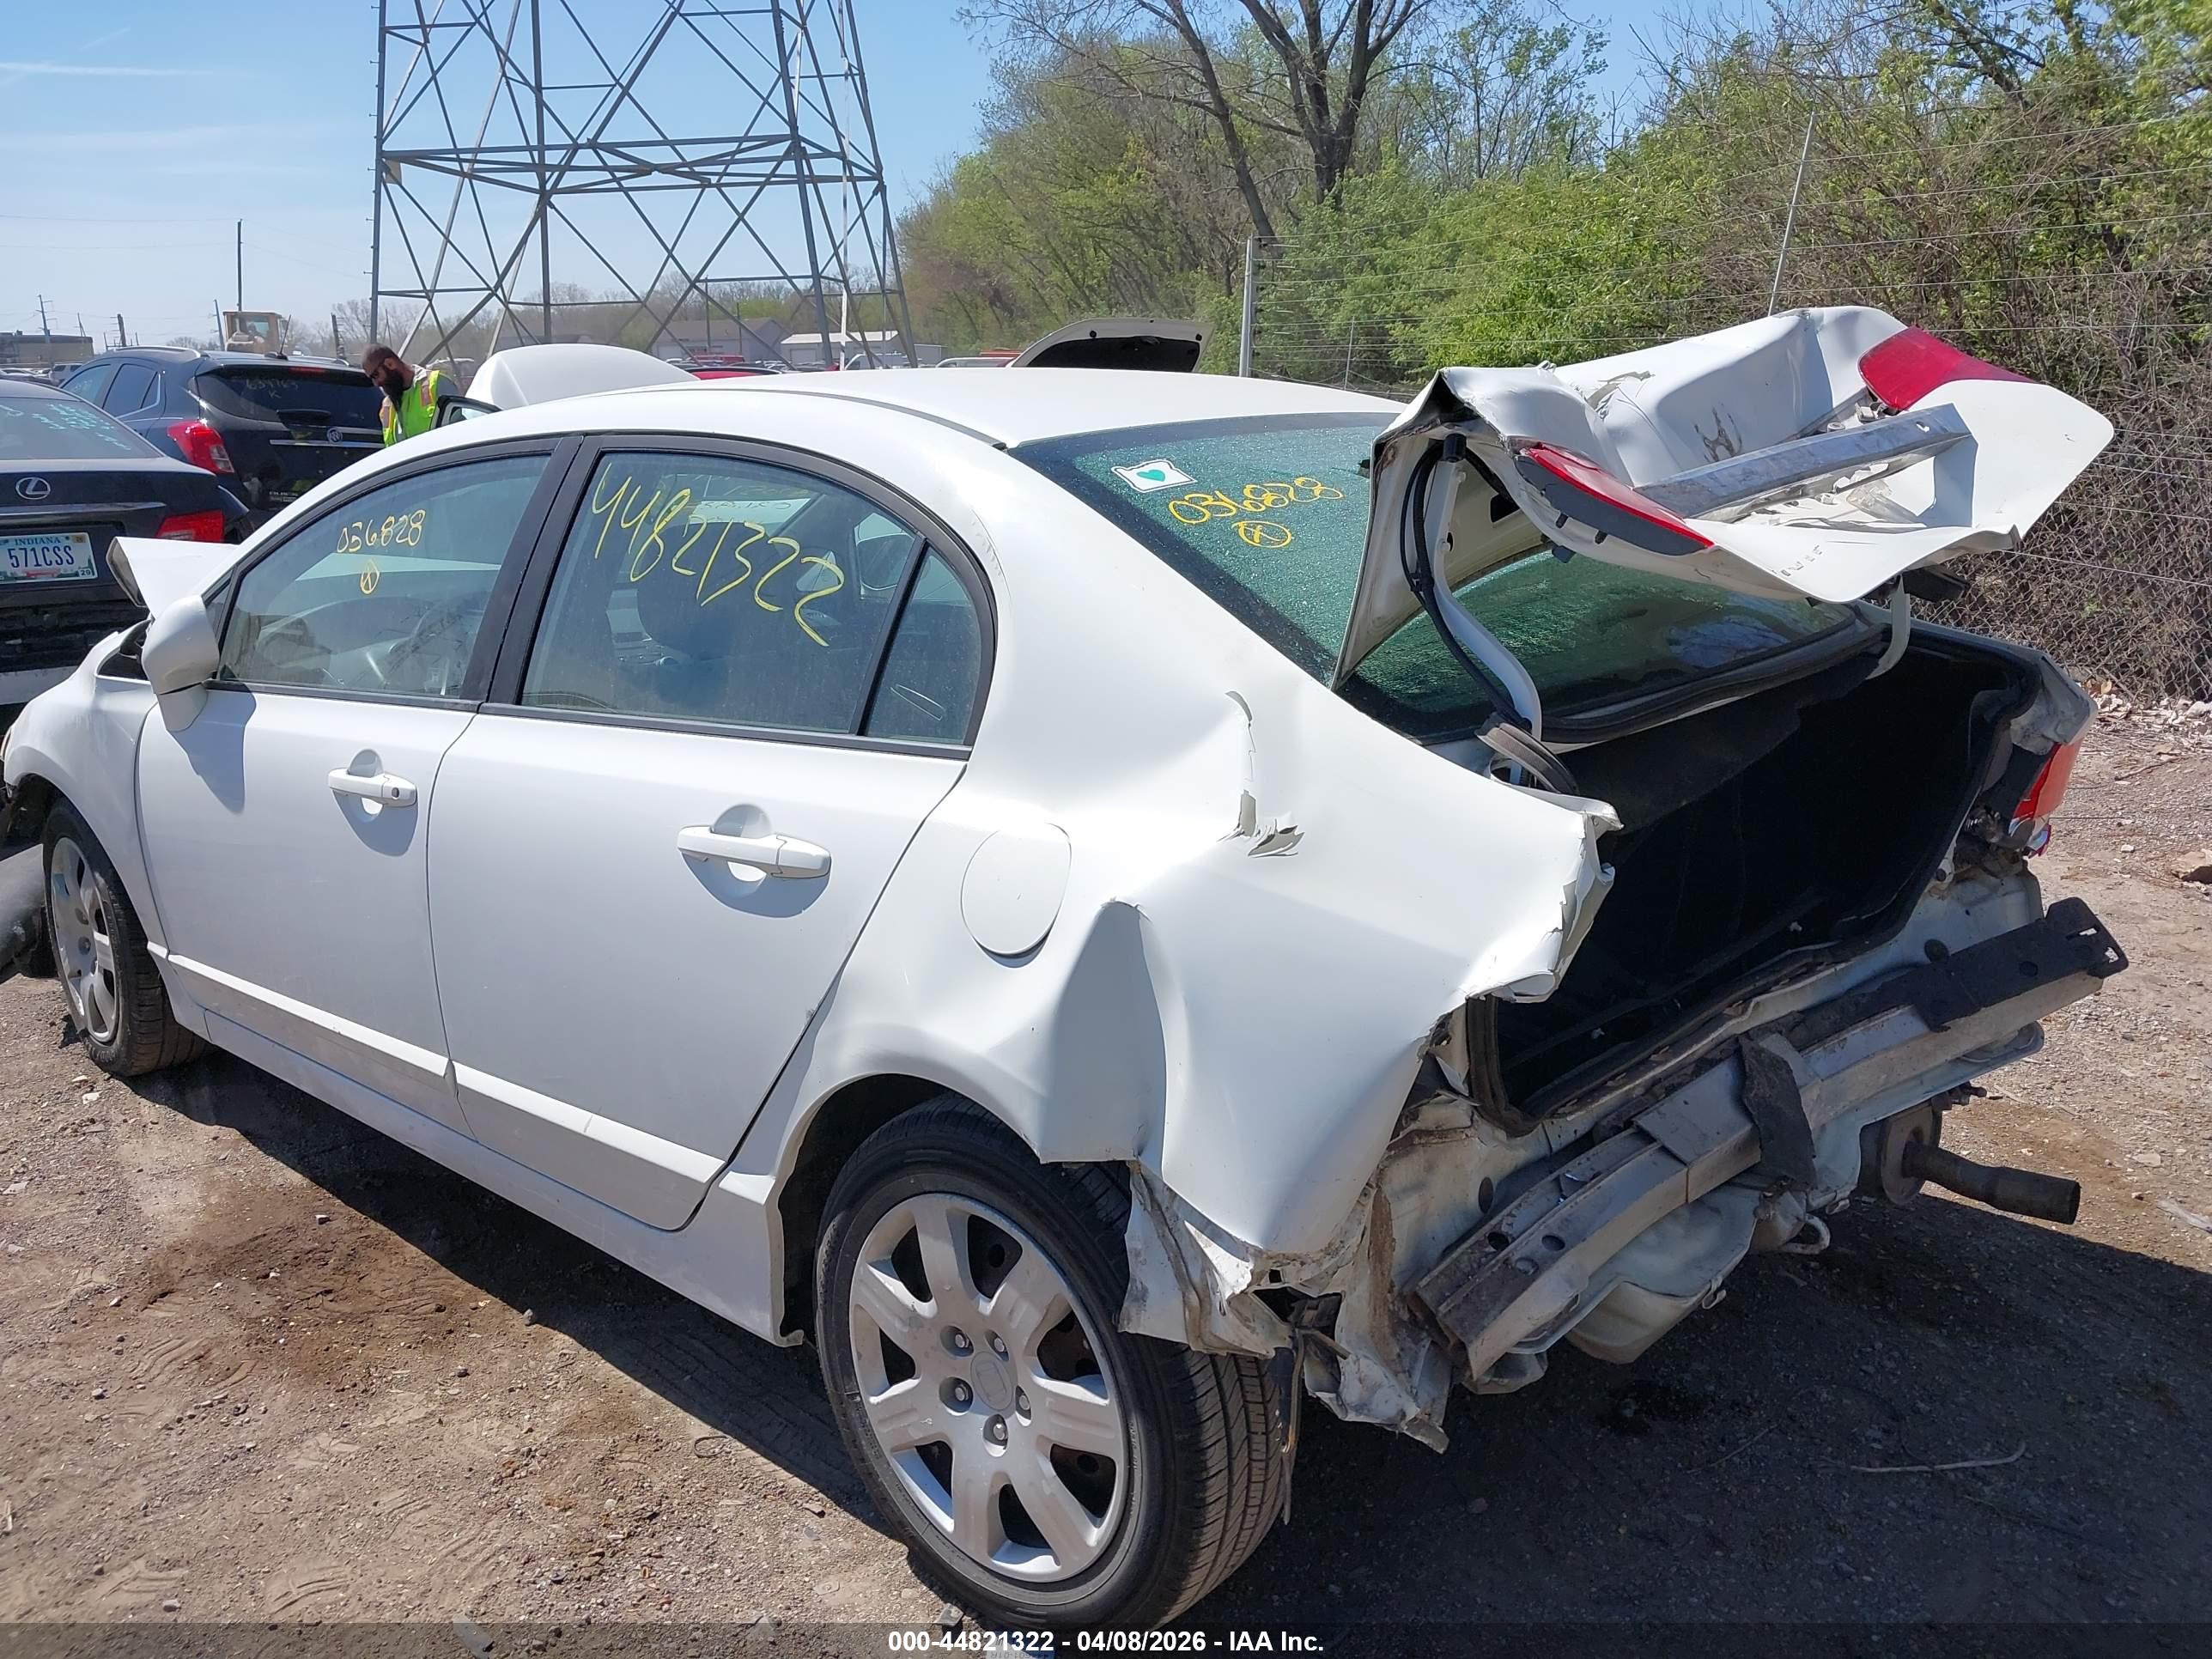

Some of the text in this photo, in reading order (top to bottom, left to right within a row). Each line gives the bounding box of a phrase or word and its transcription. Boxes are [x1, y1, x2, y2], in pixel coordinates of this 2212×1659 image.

[15, 536, 61, 545] INDIANA
[337, 509, 426, 553] 056828
[7, 545, 75, 568] 571CSS
[592, 462, 845, 647] 44821322
